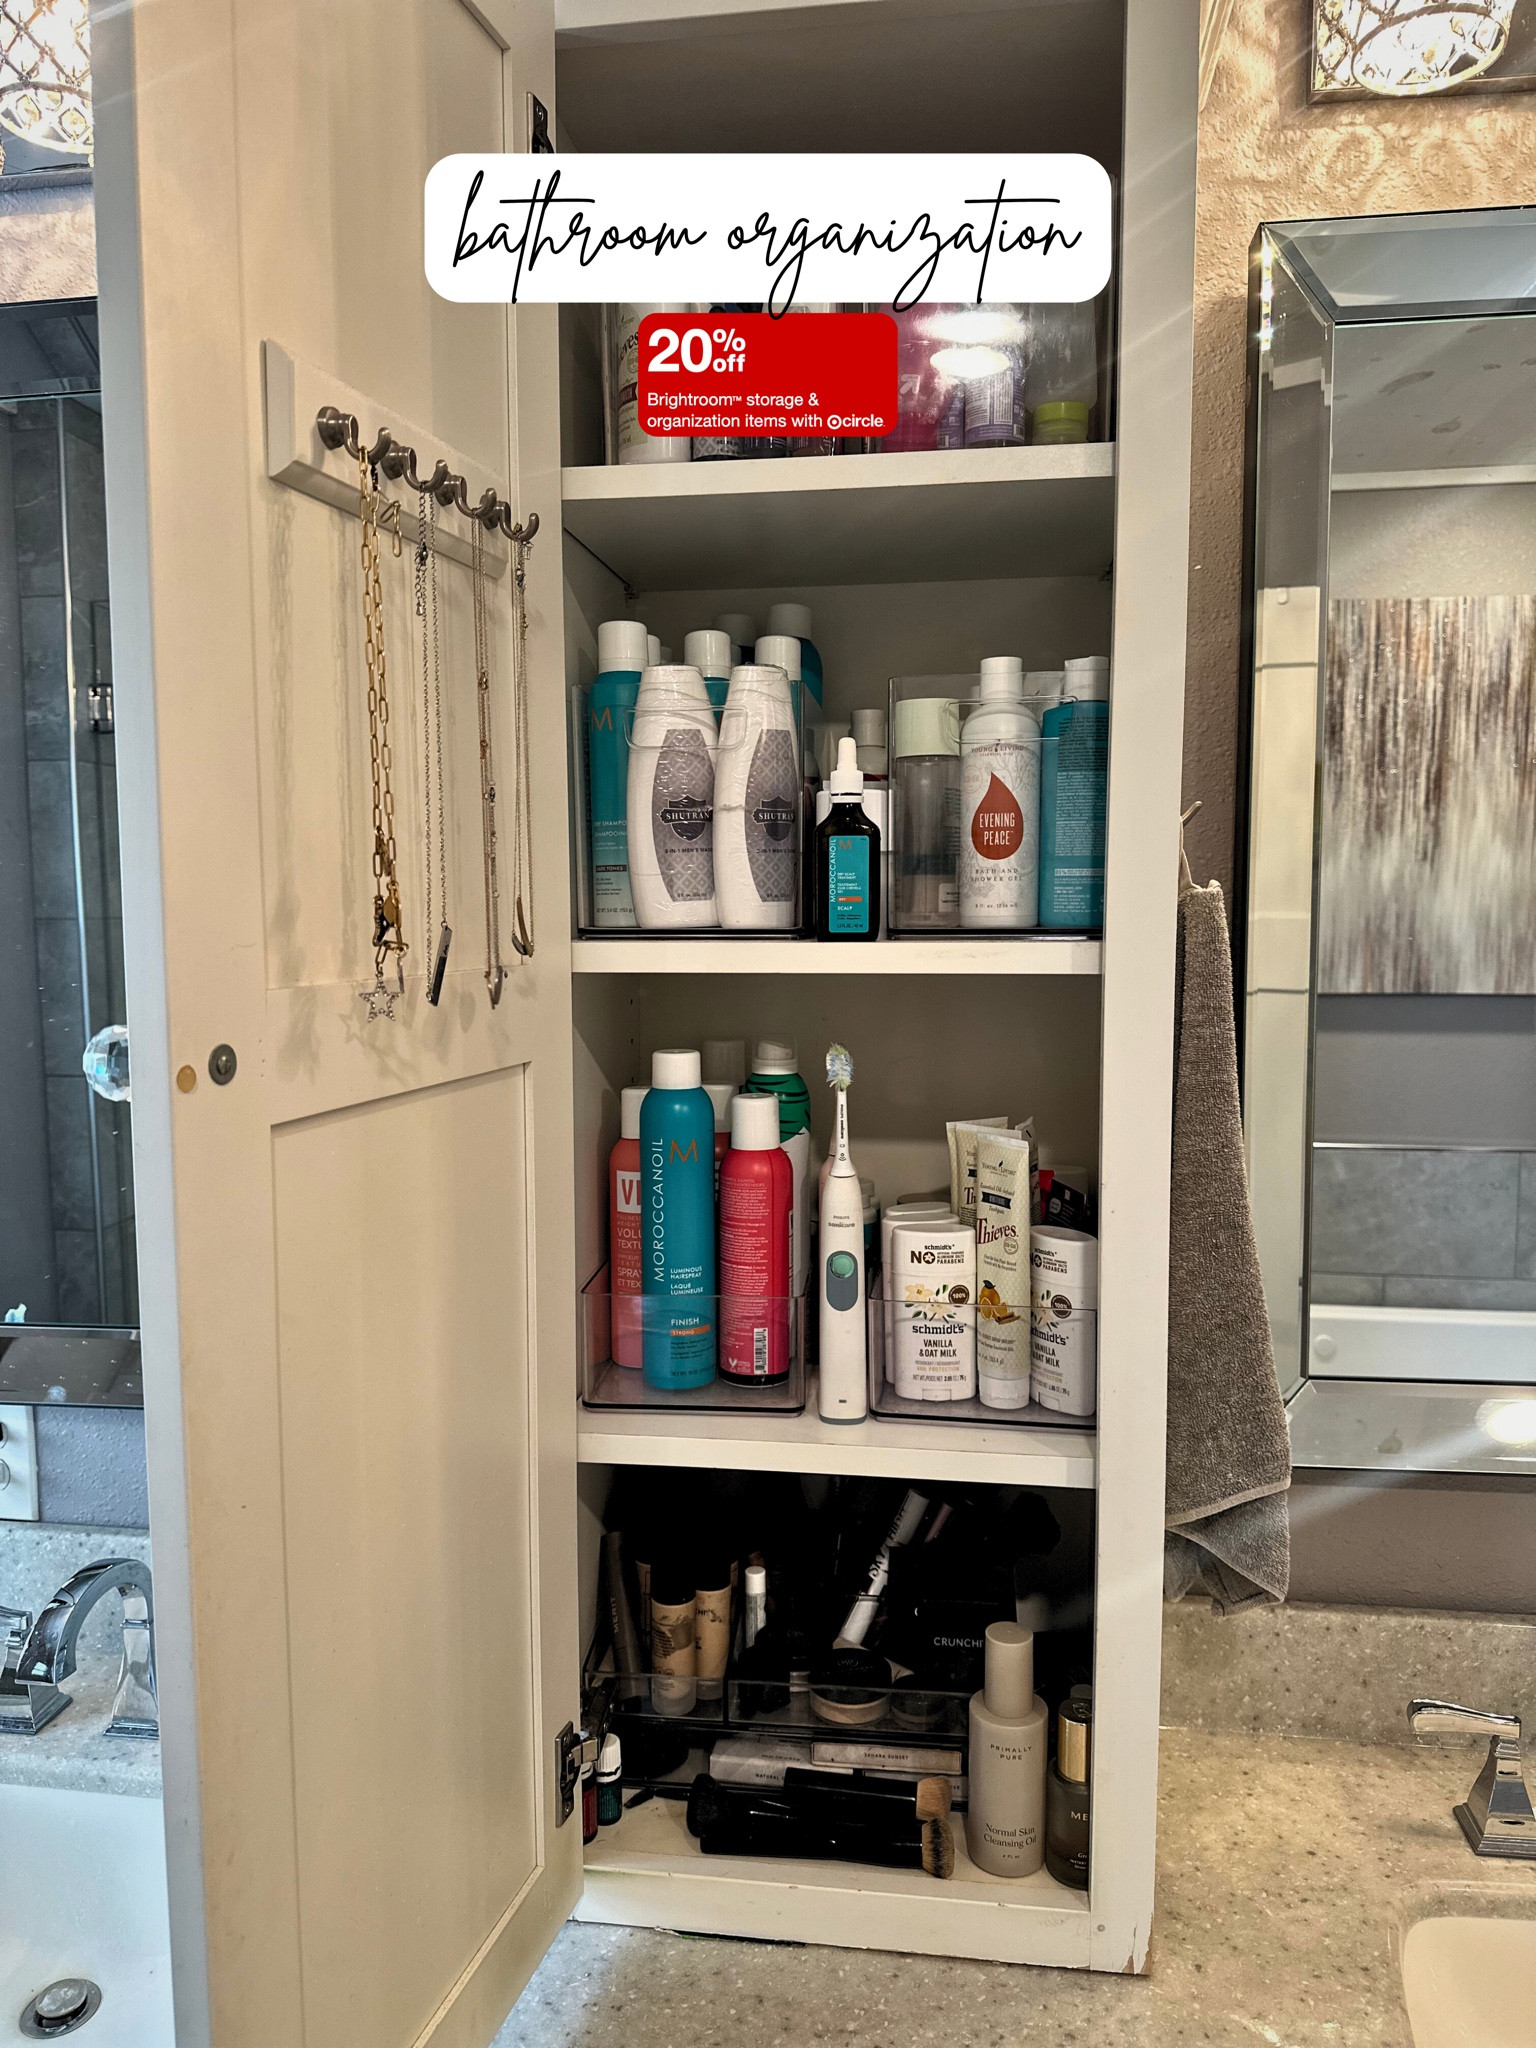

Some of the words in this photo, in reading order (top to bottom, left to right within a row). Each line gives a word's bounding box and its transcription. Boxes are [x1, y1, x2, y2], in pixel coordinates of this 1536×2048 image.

[665, 811, 710, 820] SHUTRAN
[980, 813, 1015, 828] EVENING
[669, 1138, 698, 1164] M
[652, 1138, 664, 1281] MOROCCANOIL
[670, 1266, 702, 1274] LUMINOUS
[670, 1287, 704, 1295] LUMINEUSE
[671, 1317, 700, 1326] FINISH
[912, 1324, 964, 1334] schmidt's
[923, 1339, 953, 1348] VANILLA
[940, 1349, 957, 1357] MILK
[1045, 1356, 1060, 1368] MILK
[990, 1744, 1032, 1753] PRIMALLY
[1070, 1811, 1088, 1821] ME
[985, 1823, 1017, 1837] Normal
[1018, 1827, 1035, 1837] Skin
[983, 1833, 1025, 1849] Cleansing
[1025, 1835, 1037, 1845] Oil
